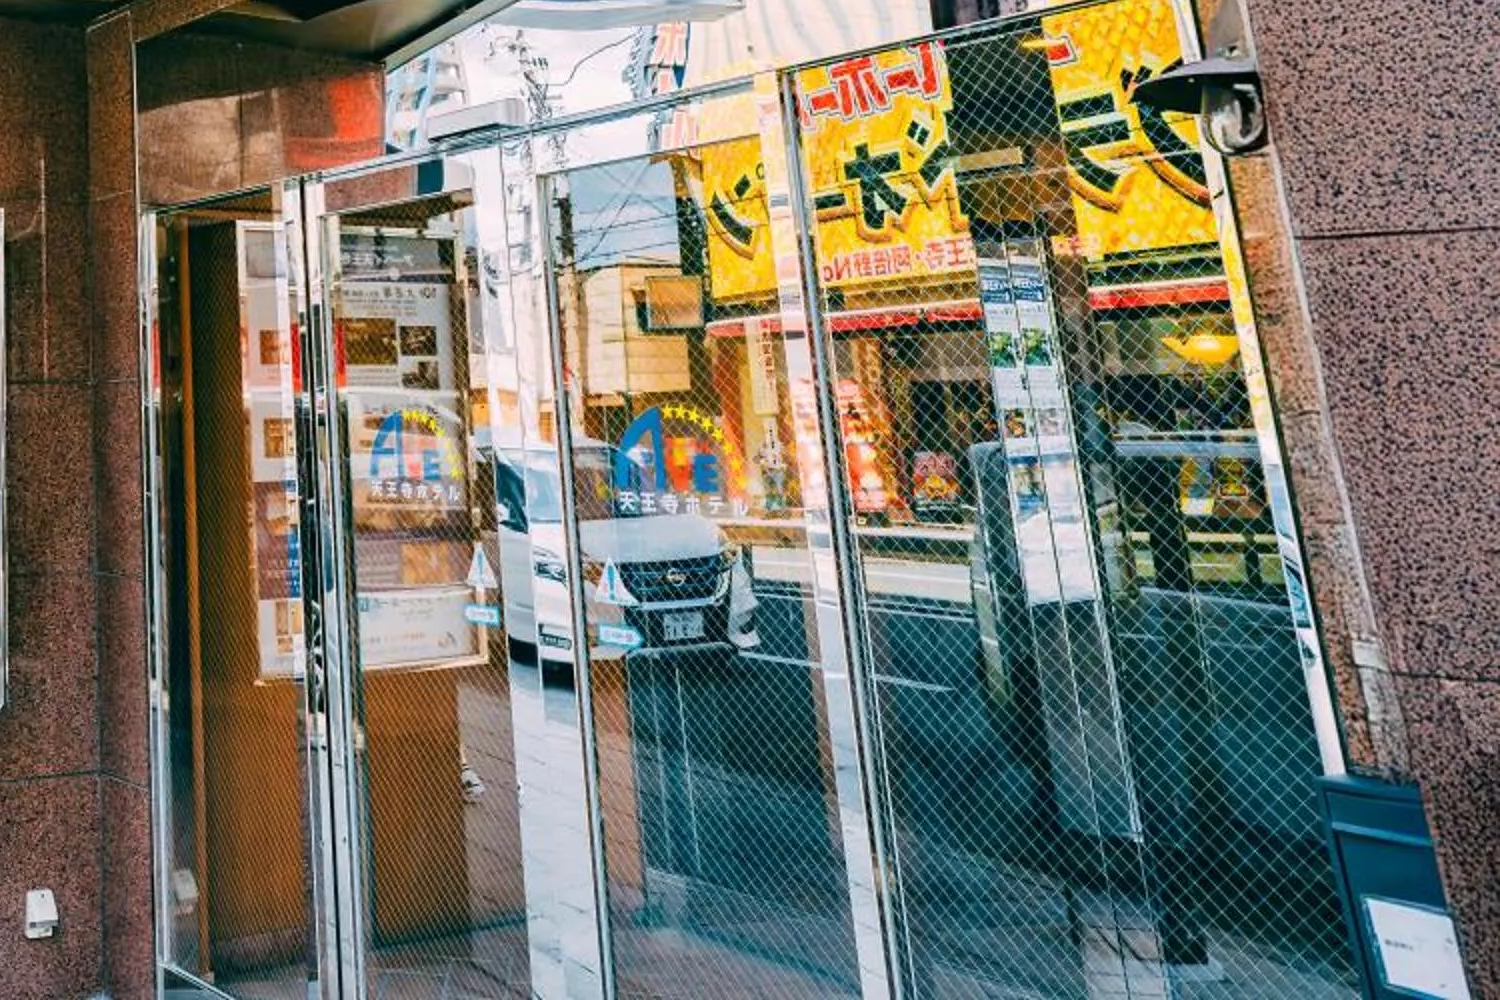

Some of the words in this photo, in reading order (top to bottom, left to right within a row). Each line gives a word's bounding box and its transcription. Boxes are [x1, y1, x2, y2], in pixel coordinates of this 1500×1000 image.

[370, 480, 461, 501] 天王寺ホテル
[618, 491, 749, 516] 天王寺ホテル
